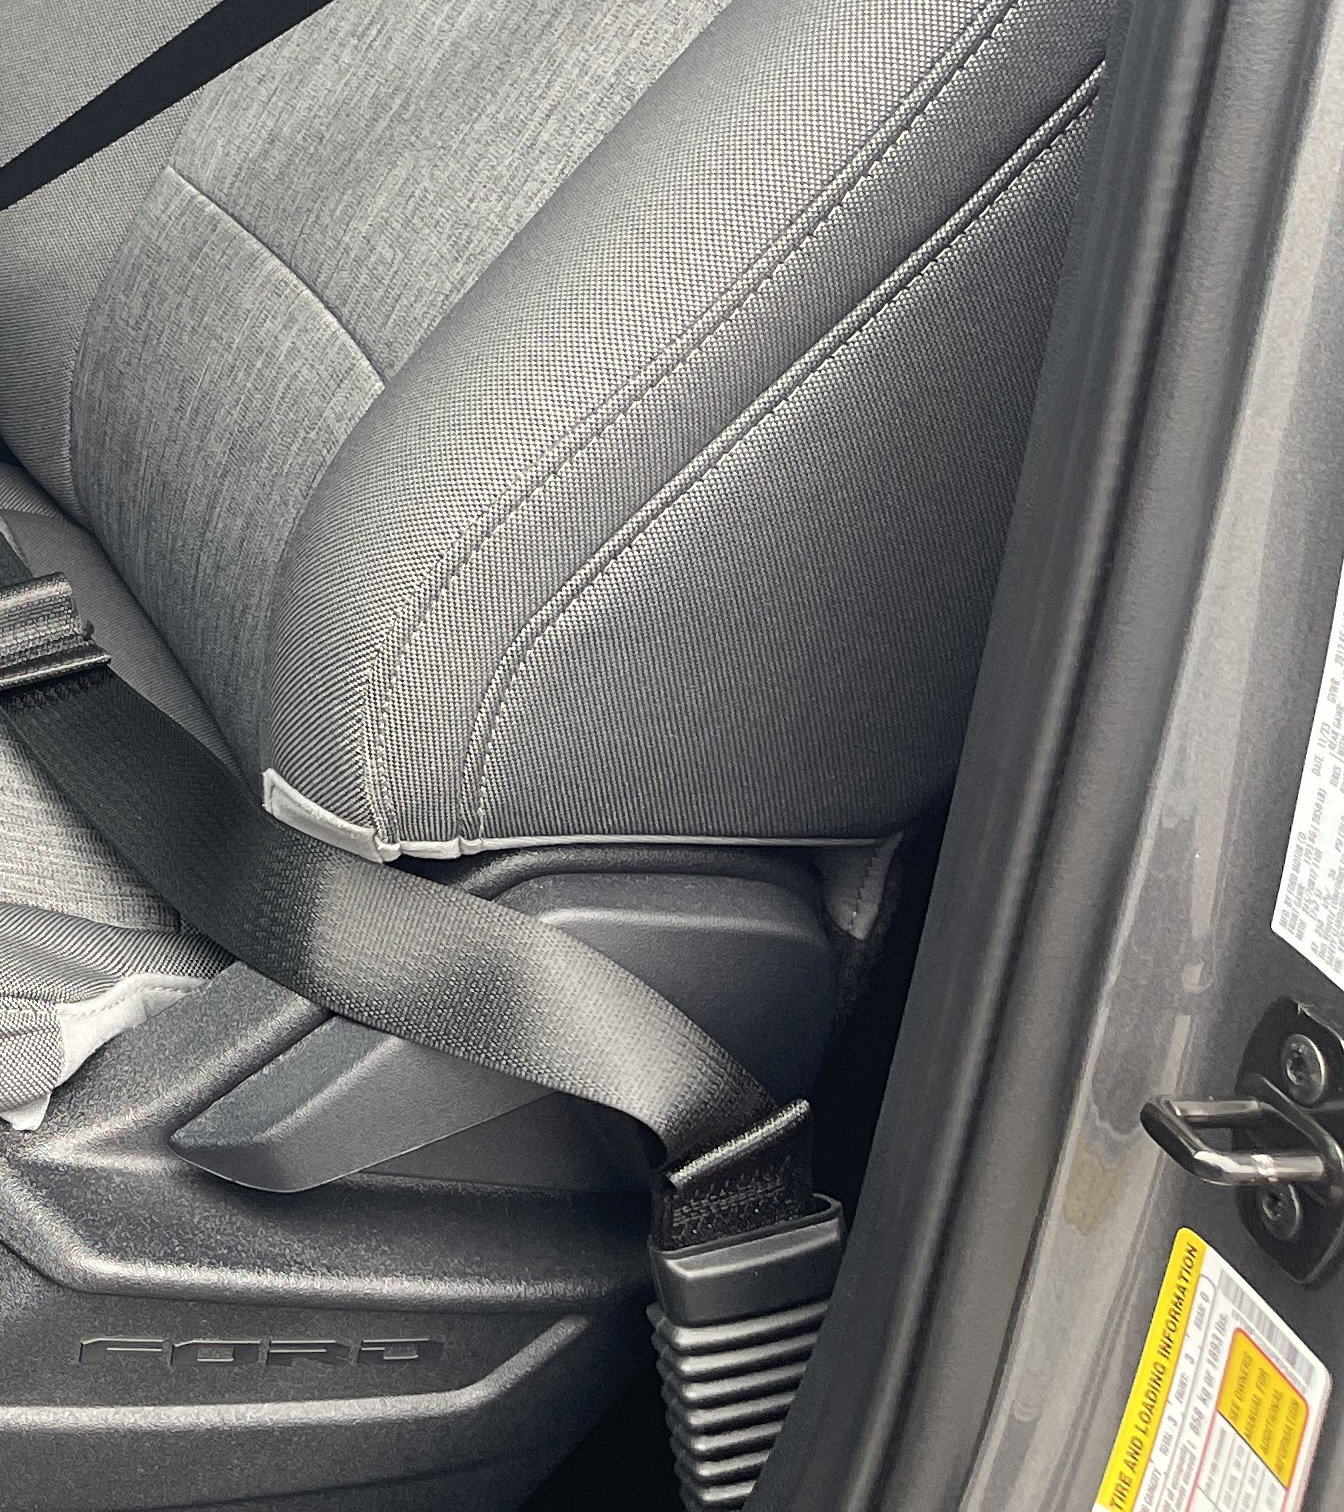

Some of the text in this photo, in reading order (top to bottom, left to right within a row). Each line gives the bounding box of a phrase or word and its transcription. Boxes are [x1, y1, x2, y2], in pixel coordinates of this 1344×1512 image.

[78, 1336, 445, 1370] FORD
[1110, 1242, 1198, 1510] TIRE AND LOADING INFORMATION
[1203, 1370, 1214, 1388] or
[1196, 1386, 1212, 1406] kg
